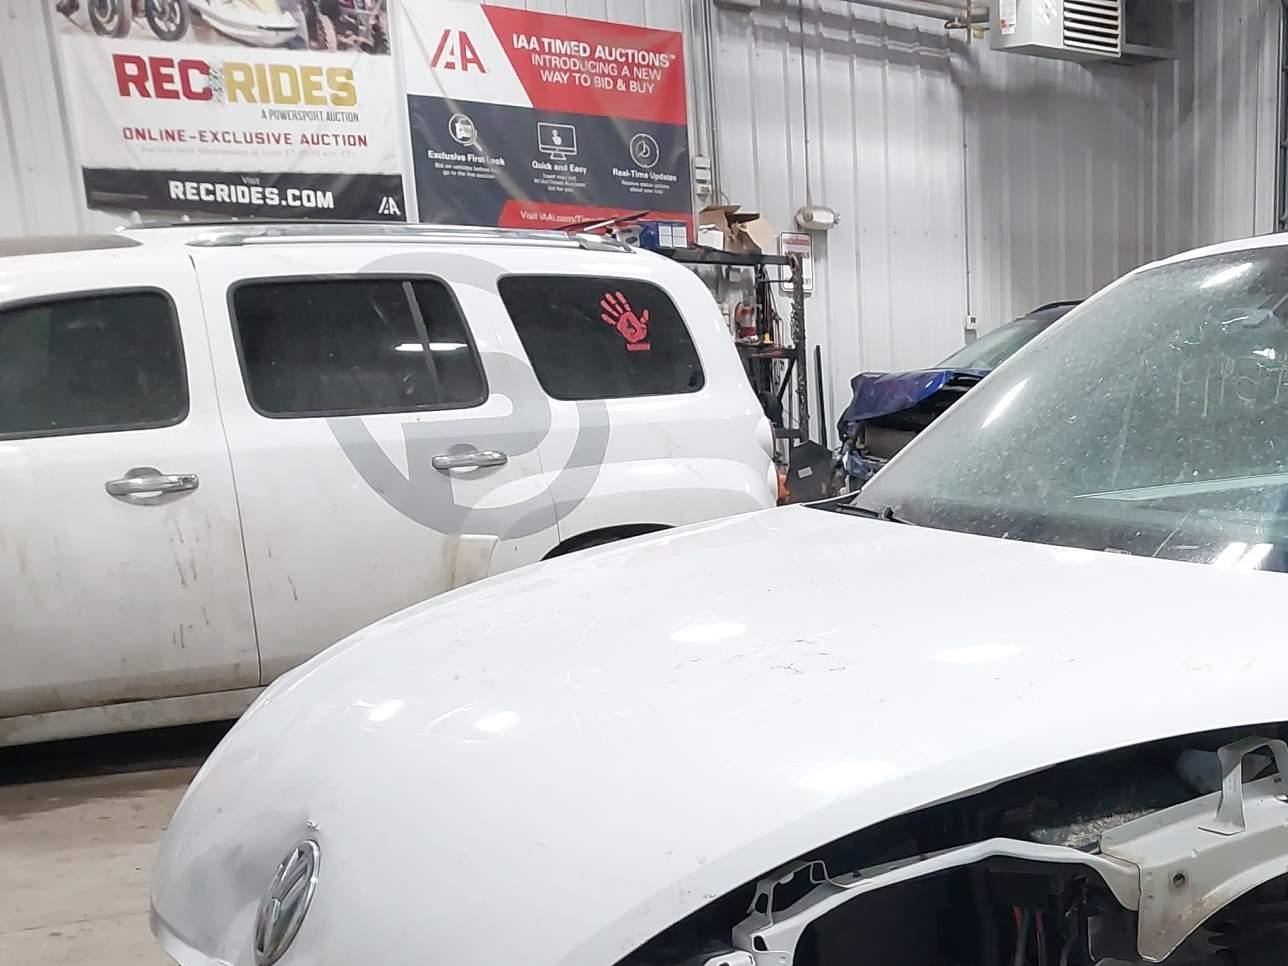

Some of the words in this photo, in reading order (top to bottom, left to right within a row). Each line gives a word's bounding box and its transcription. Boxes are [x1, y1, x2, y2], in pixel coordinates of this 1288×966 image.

[512, 33, 539, 51] IAA
[541, 37, 591, 58] TIMED
[531, 53, 618, 76] INTRODUCING
[621, 65, 631, 78] A
[633, 68, 662, 81] NEW
[112, 54, 213, 101] REC
[222, 61, 358, 107] RIDES
[540, 70, 569, 84] WAY
[572, 73, 591, 87] TO
[593, 76, 613, 91] BID
[616, 80, 627, 92] &
[629, 81, 655, 95] BUY
[261, 109, 268, 120] A
[269, 109, 324, 121] POWERSPORT
[326, 111, 359, 122] AUCTION
[122, 127, 293, 146] ONLINE-EXCLUSIVE
[299, 133, 368, 148] AUCTION
[427, 150, 466, 162] Exclusive
[467, 153, 485, 164] First
[531, 160, 552, 171] Quick
[553, 162, 568, 172] and
[569, 163, 588, 175] Easy
[612, 167, 649, 180] Real-Time
[650, 170, 678, 183] Updates
[168, 180, 335, 209] RECRIDES.COM
[520, 210, 538, 221] Visit
